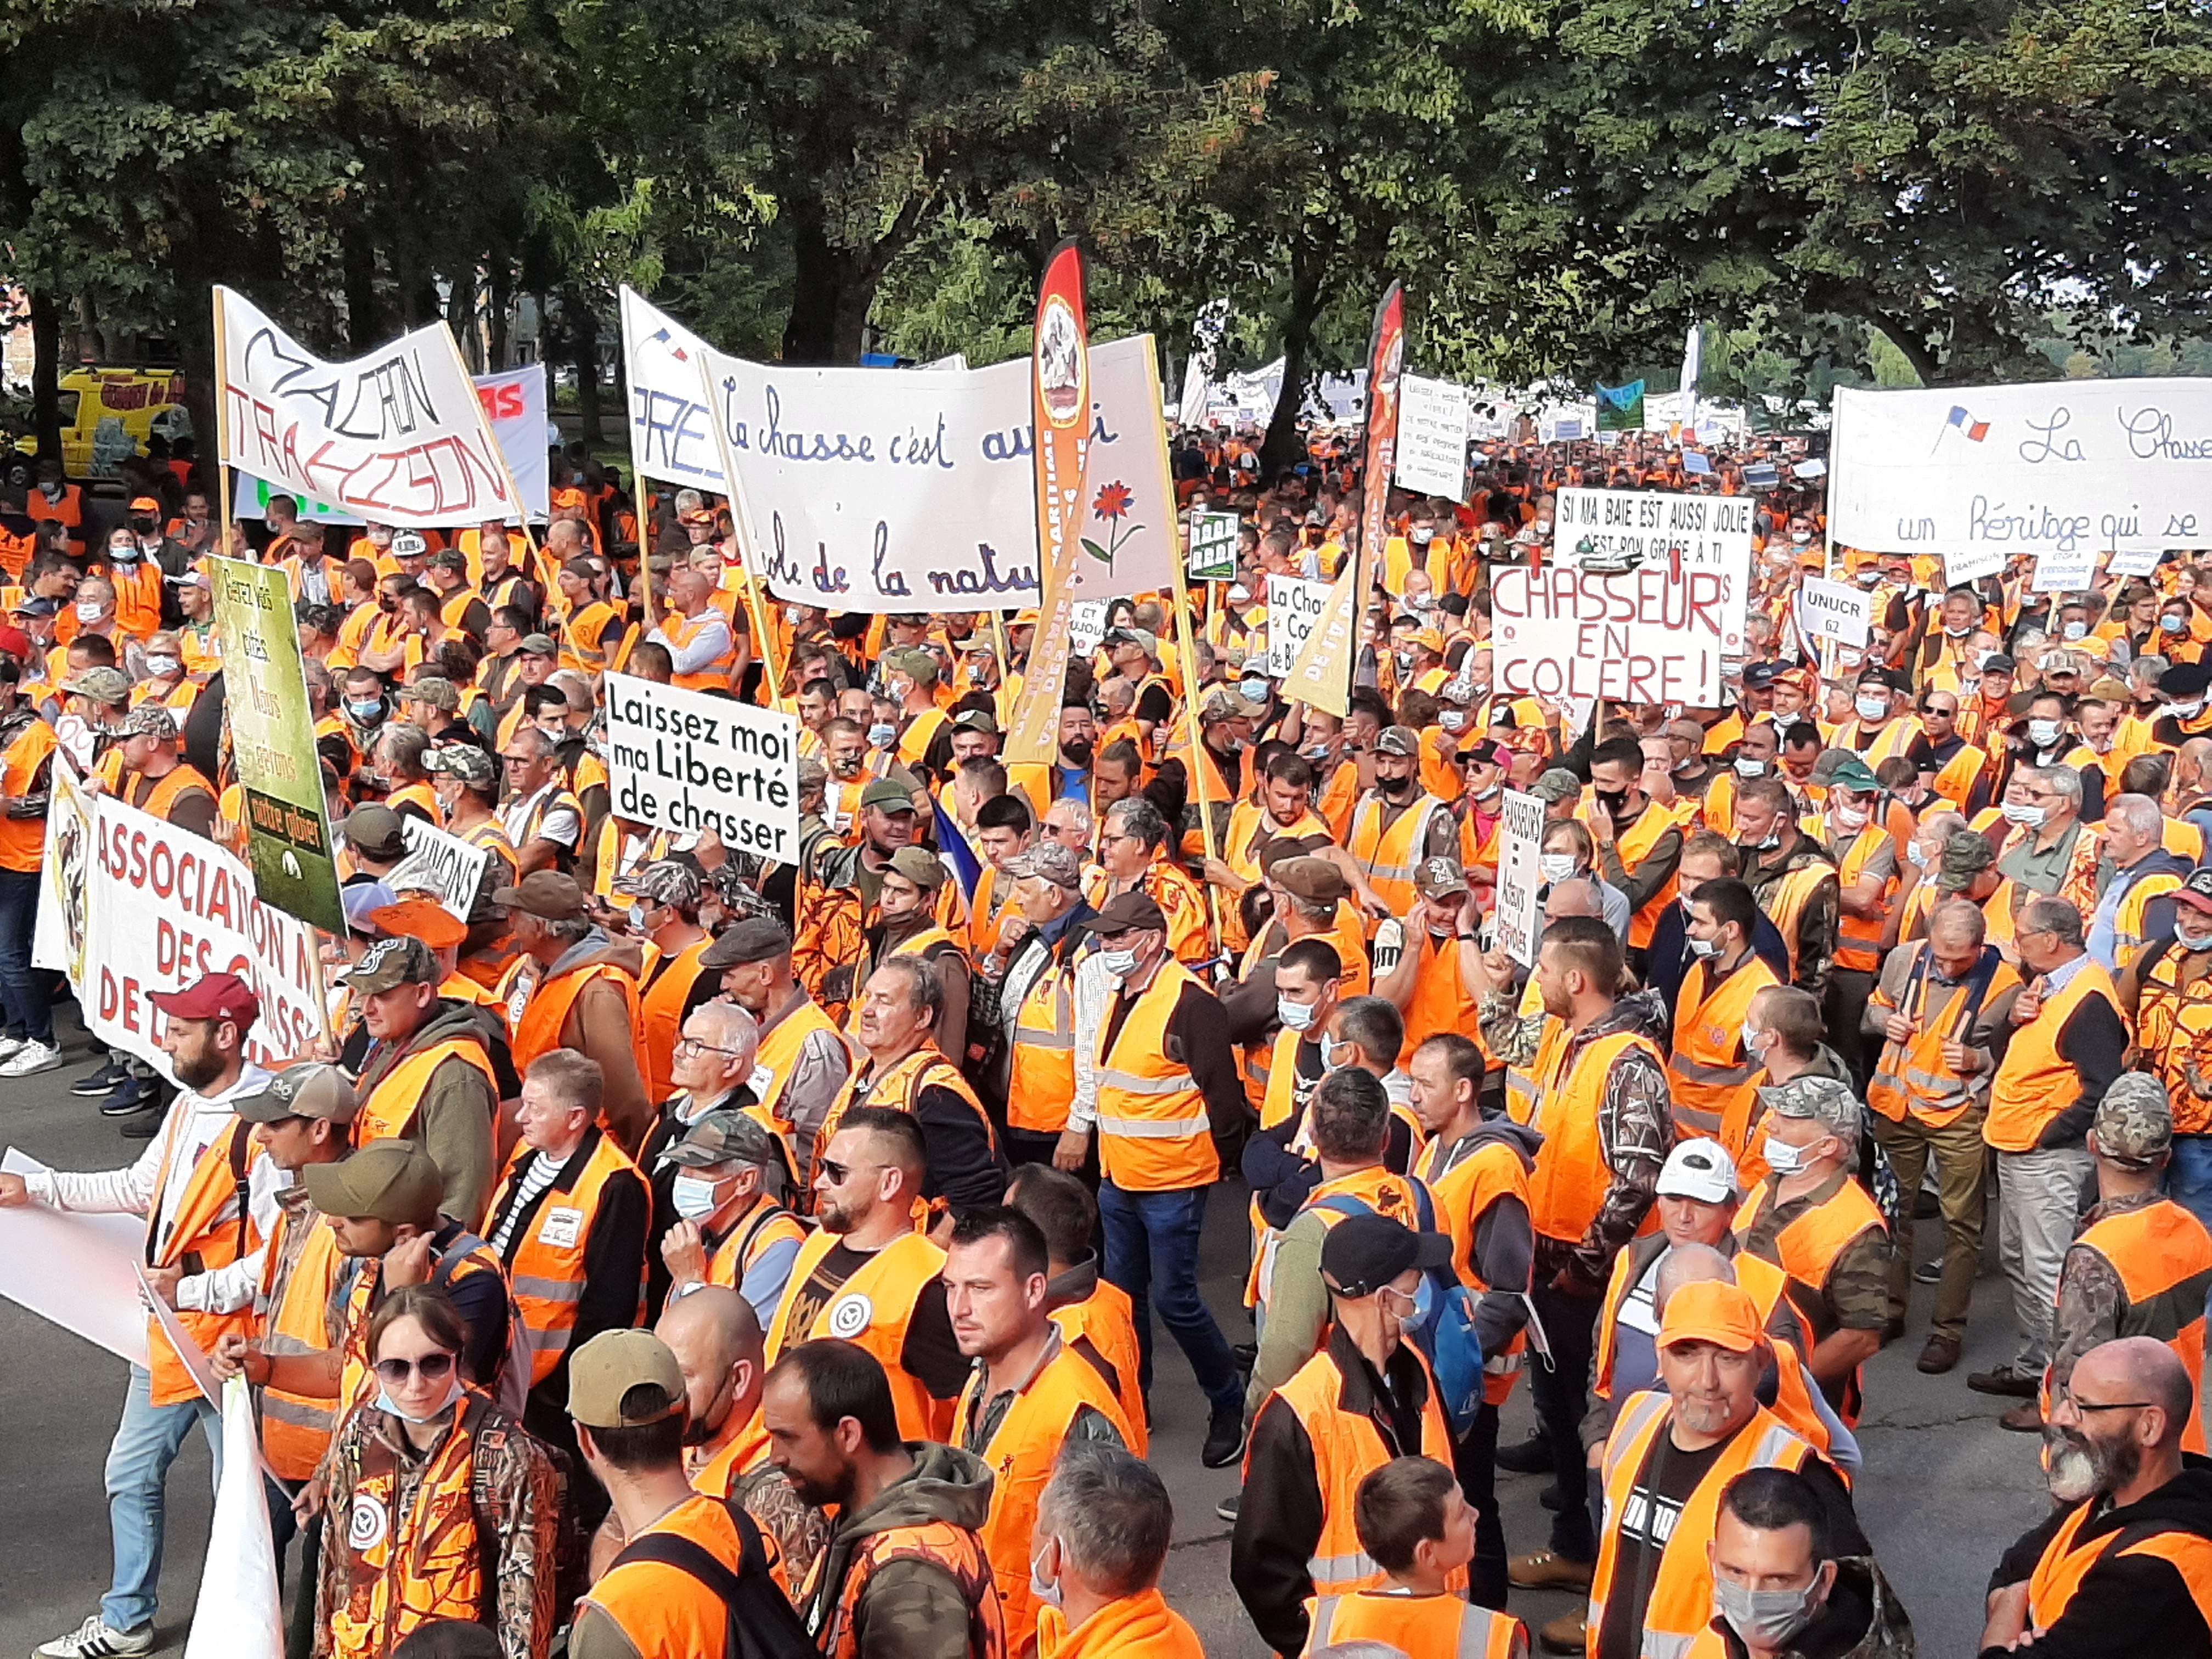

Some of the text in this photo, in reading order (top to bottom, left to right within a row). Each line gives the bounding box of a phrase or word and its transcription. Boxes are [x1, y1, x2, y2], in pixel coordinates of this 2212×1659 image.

[225, 383, 507, 517] TRAHISON
[723, 375, 1119, 469] La chasse c'est aui
[2019, 407, 2086, 463] La
[1562, 495, 1748, 534] SI MA BAIE EST AUSSI JOLIE
[1898, 494, 2199, 551] un héritage qui se
[812, 541, 850, 594] de
[871, 521, 912, 596] la
[1271, 580, 1327, 615] La Cha
[1808, 590, 1861, 619] UNUCR
[1577, 623, 1630, 658] EN
[609, 682, 789, 764] Laissez moi
[613, 738, 789, 809] ma Liberté
[620, 772, 787, 853] de chasser
[156, 917, 212, 986] DES
[100, 963, 140, 1034] DE
